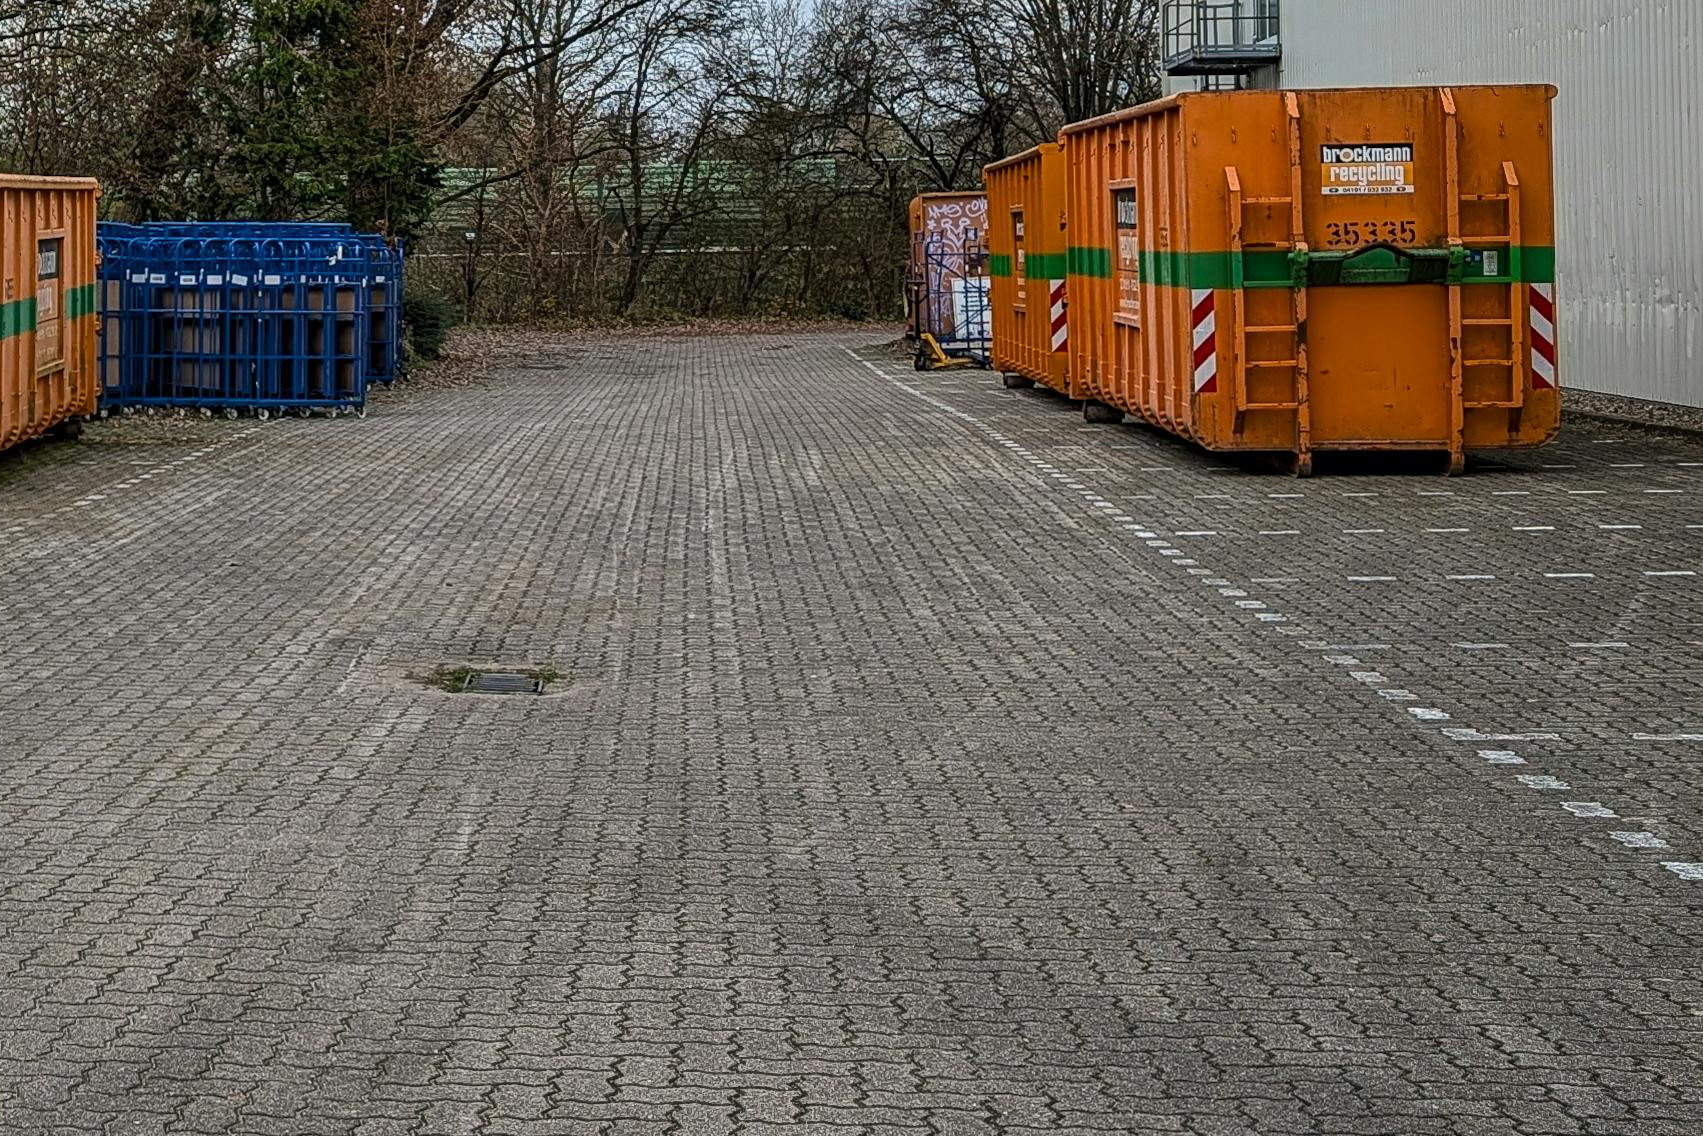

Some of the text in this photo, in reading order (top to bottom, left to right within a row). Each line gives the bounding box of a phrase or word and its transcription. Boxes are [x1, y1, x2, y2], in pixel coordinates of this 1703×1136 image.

[1322, 146, 1411, 163] brockmann
[1330, 164, 1405, 185] recycling
[1326, 221, 1416, 245] 35335
